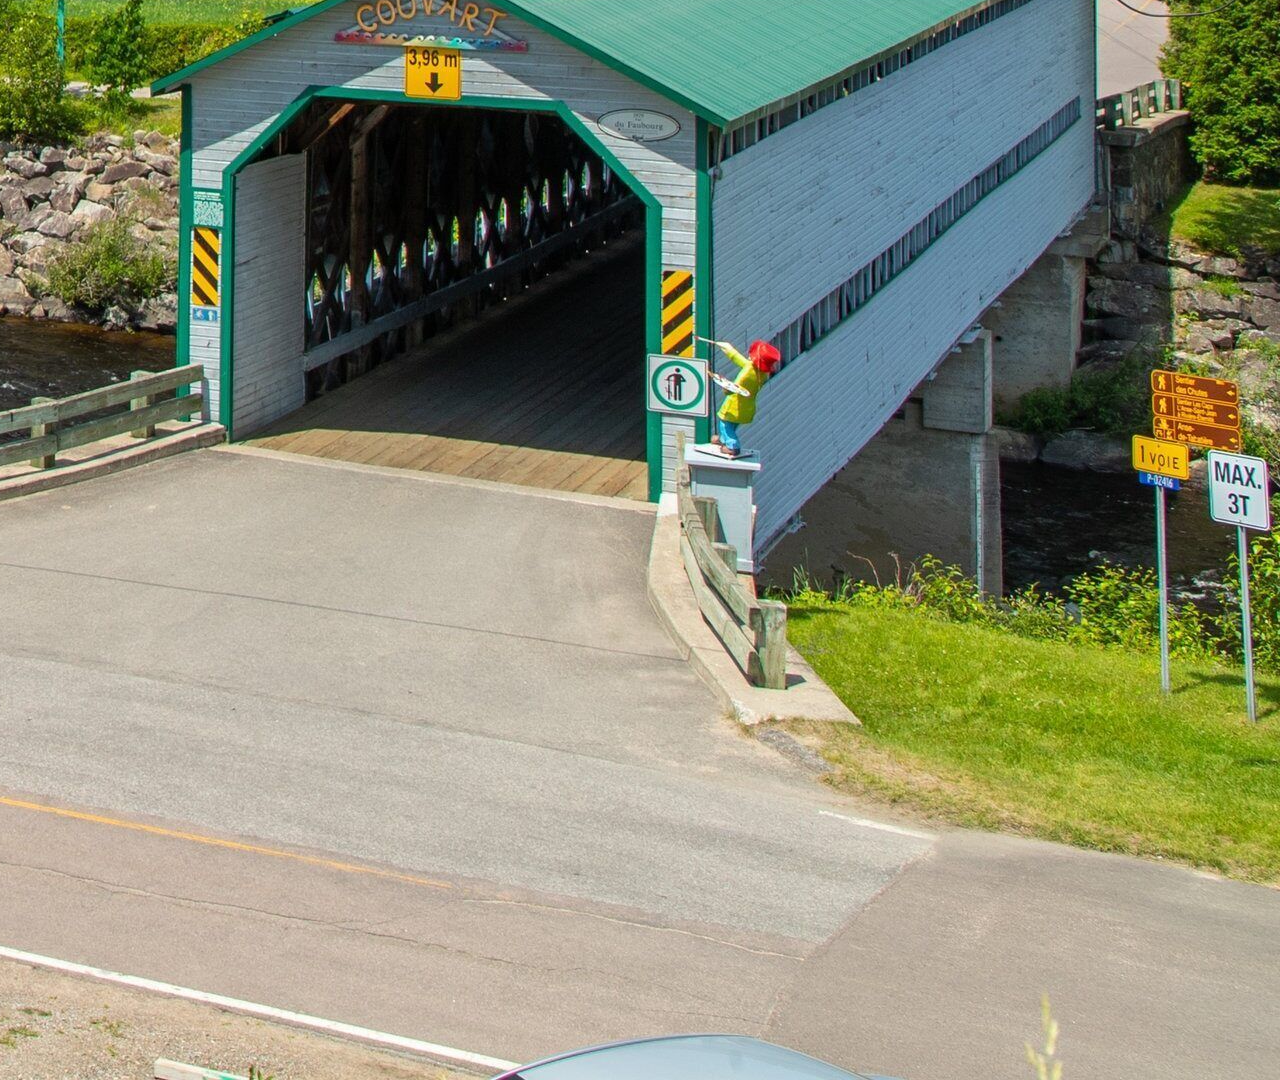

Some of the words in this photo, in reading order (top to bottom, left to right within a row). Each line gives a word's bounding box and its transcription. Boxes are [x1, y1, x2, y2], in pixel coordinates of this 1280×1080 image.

[408, 48, 439, 69] 3,96
[444, 53, 457, 67] m
[627, 121, 663, 131] Faubourg
[1175, 375, 1196, 386] Sentier
[1176, 386, 1187, 394] des
[1187, 387, 1208, 398] Chutes
[1140, 445, 1145, 463] 1
[1149, 451, 1180, 470] VOIE
[1214, 461, 1262, 489] MAX.
[1228, 493, 1250, 517] 3T
